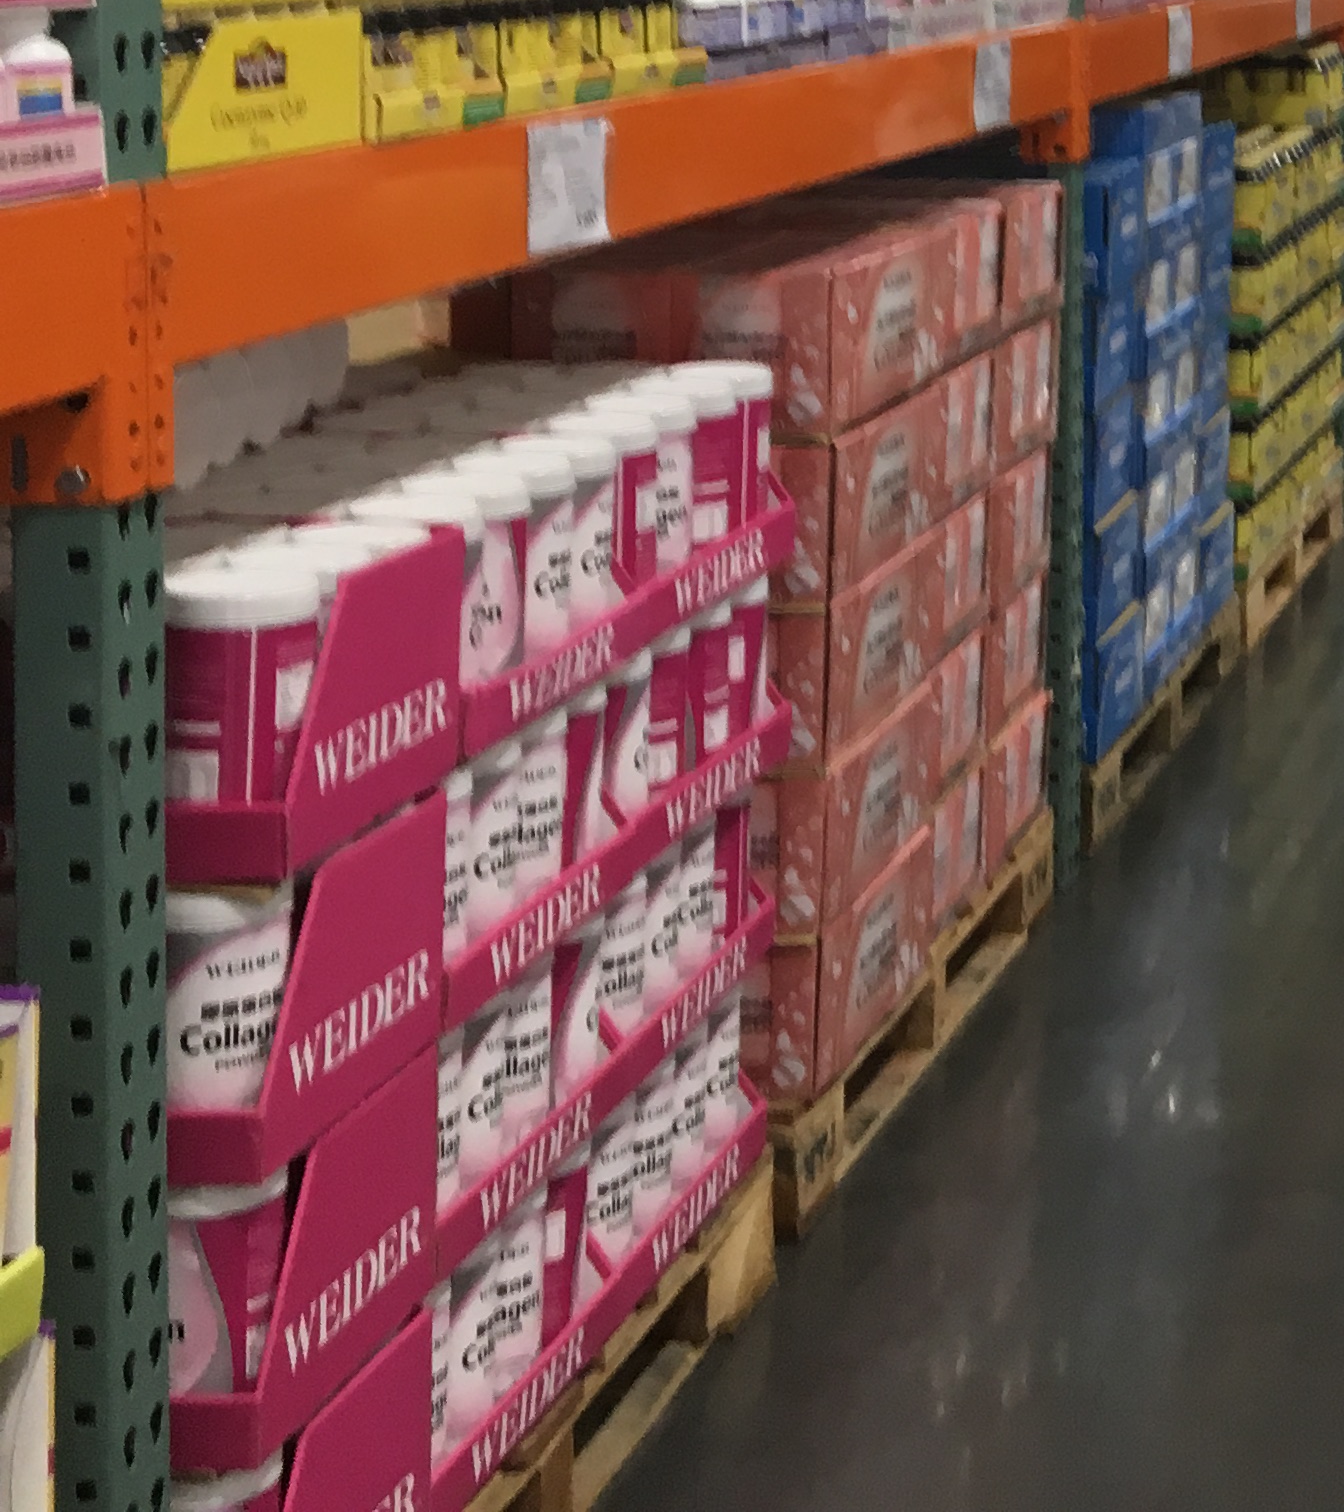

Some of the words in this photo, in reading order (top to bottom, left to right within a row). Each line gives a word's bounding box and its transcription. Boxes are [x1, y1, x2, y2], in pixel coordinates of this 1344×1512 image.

[675, 529, 766, 618] WEIDER
[509, 621, 615, 723] WEIDER
[314, 678, 448, 797] WEIDER
[665, 737, 763, 839] WEIDER
[490, 863, 602, 986] WEIDER
[288, 948, 431, 1097] WEIDER
[661, 935, 747, 1050] WEIDER
[480, 1090, 593, 1231] WEIDER
[652, 1144, 740, 1274] WEIDER
[284, 1206, 422, 1378] WEIDER
[472, 1326, 585, 1485] WEIDER
